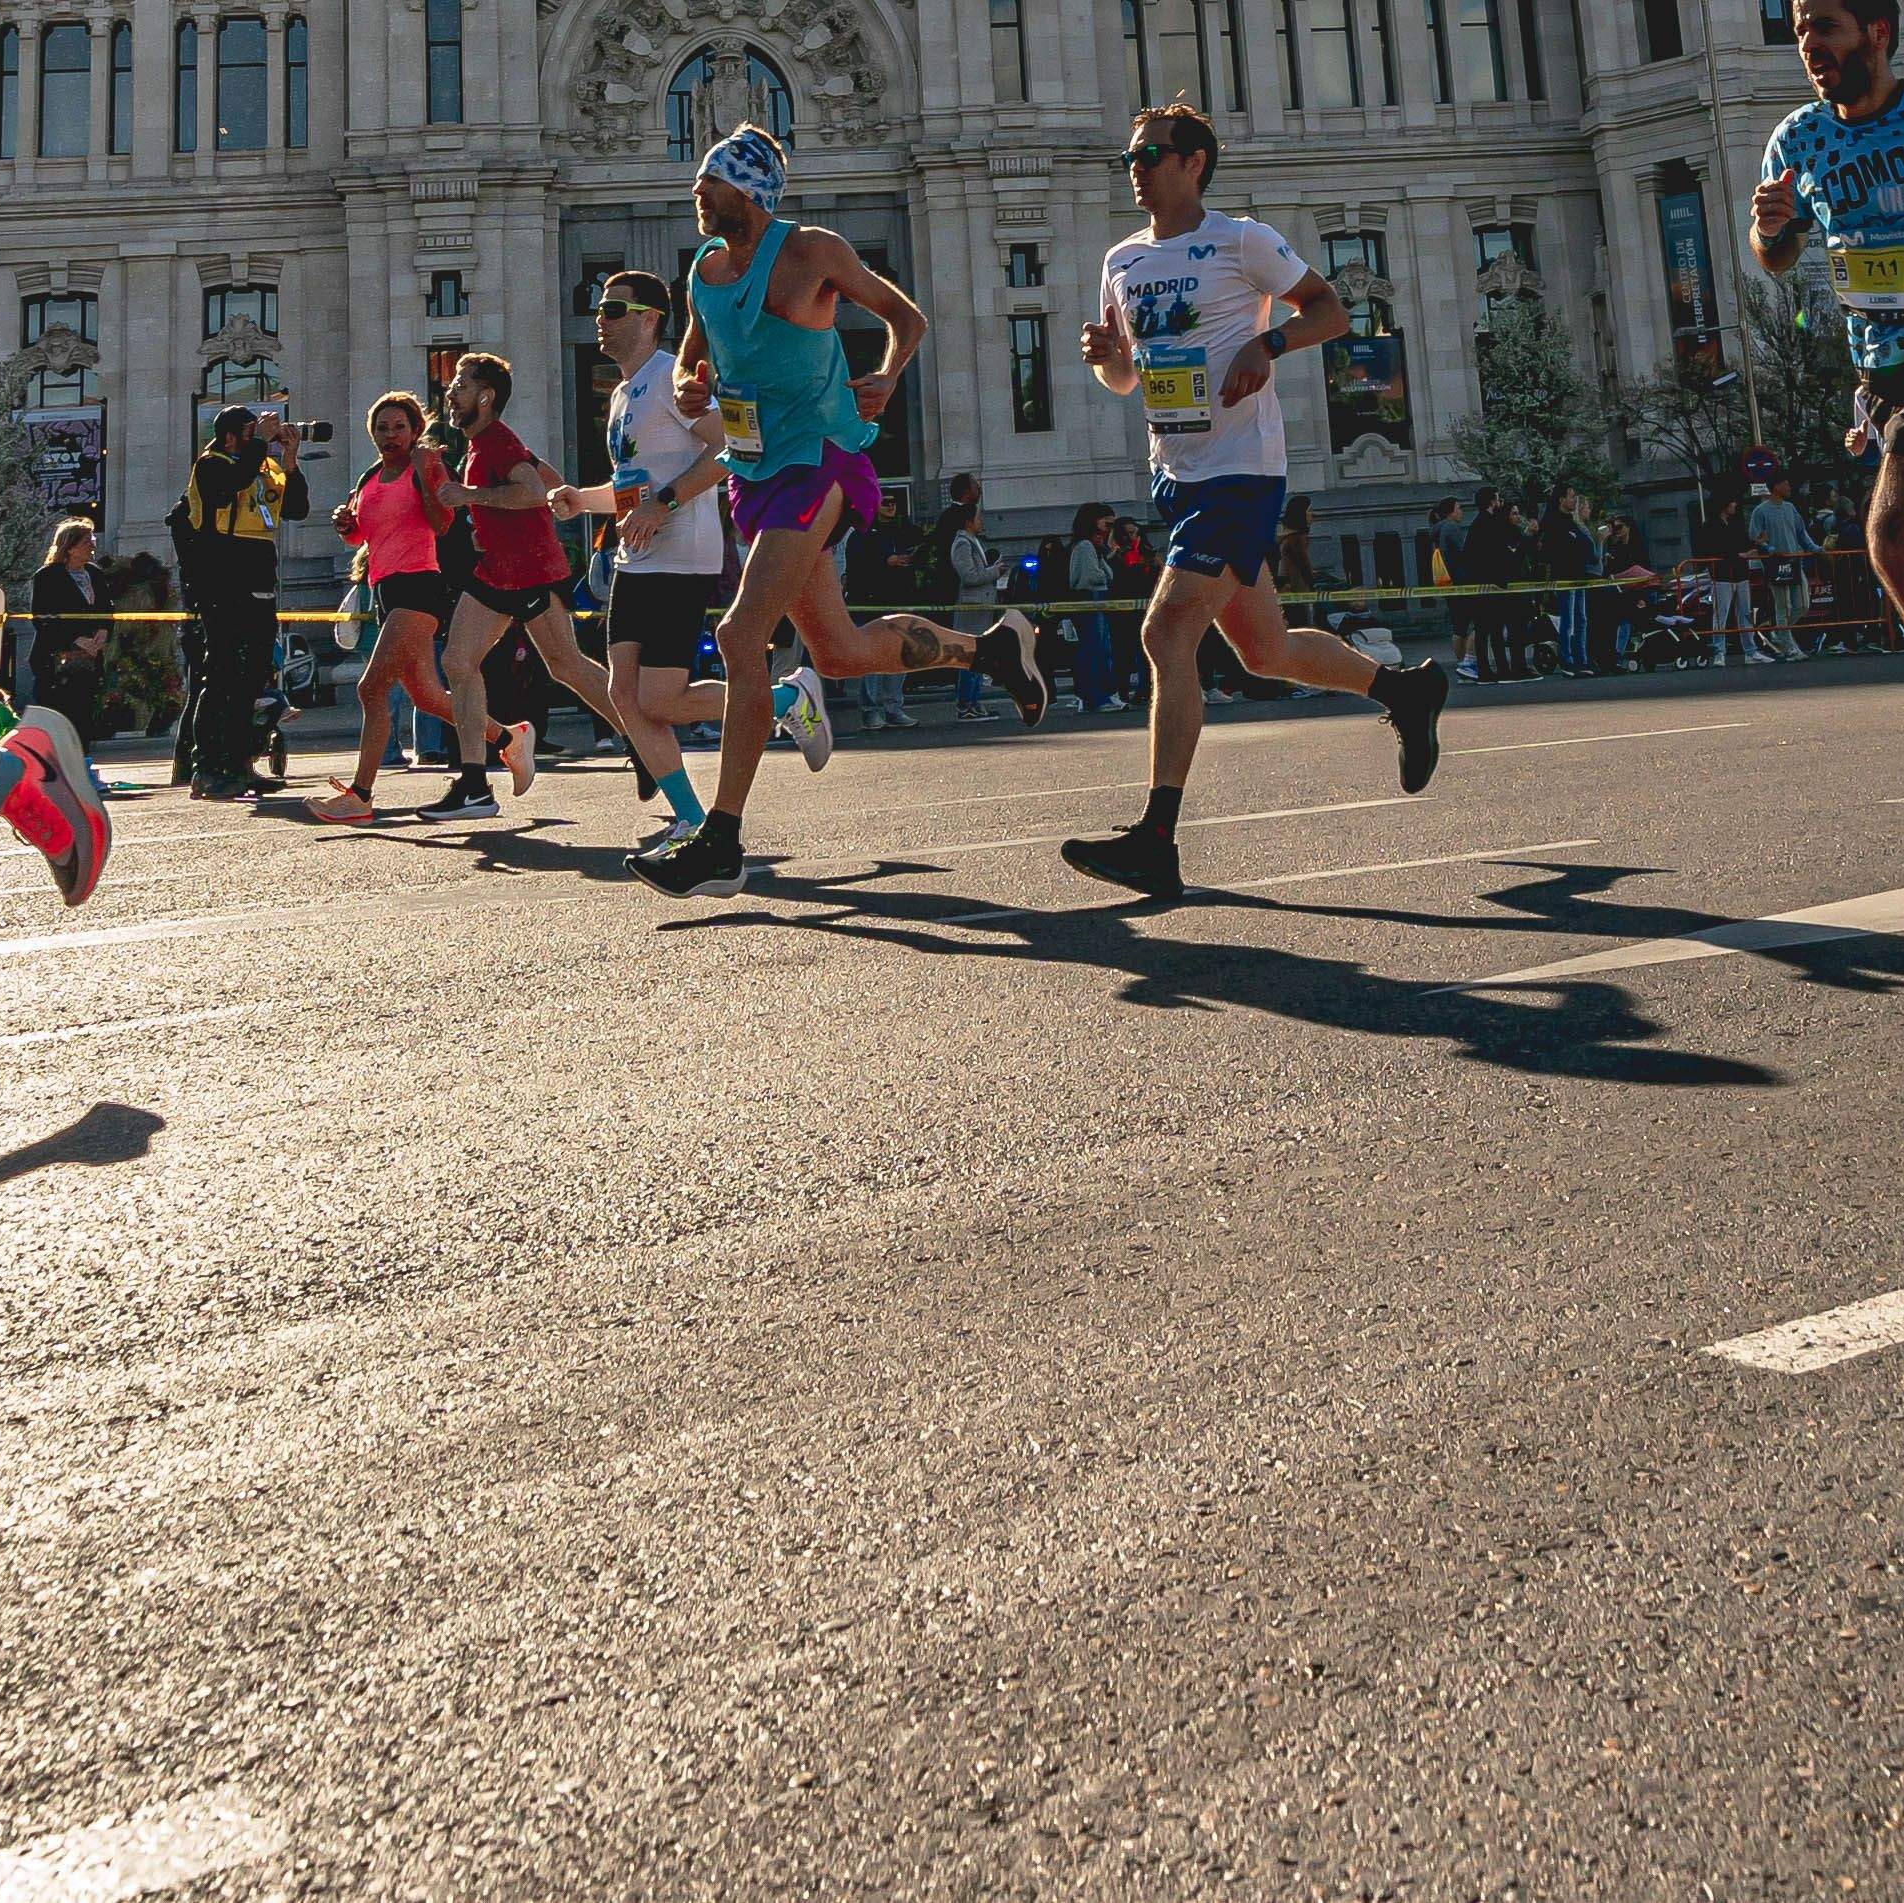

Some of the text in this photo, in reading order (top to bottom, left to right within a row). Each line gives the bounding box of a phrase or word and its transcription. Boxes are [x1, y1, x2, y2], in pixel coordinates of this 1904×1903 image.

[1675, 239, 1690, 303] CENTRO DE
[1863, 259, 1898, 277] 711
[1126, 277, 1199, 301] MADRID
[1149, 380, 1176, 394] 965
